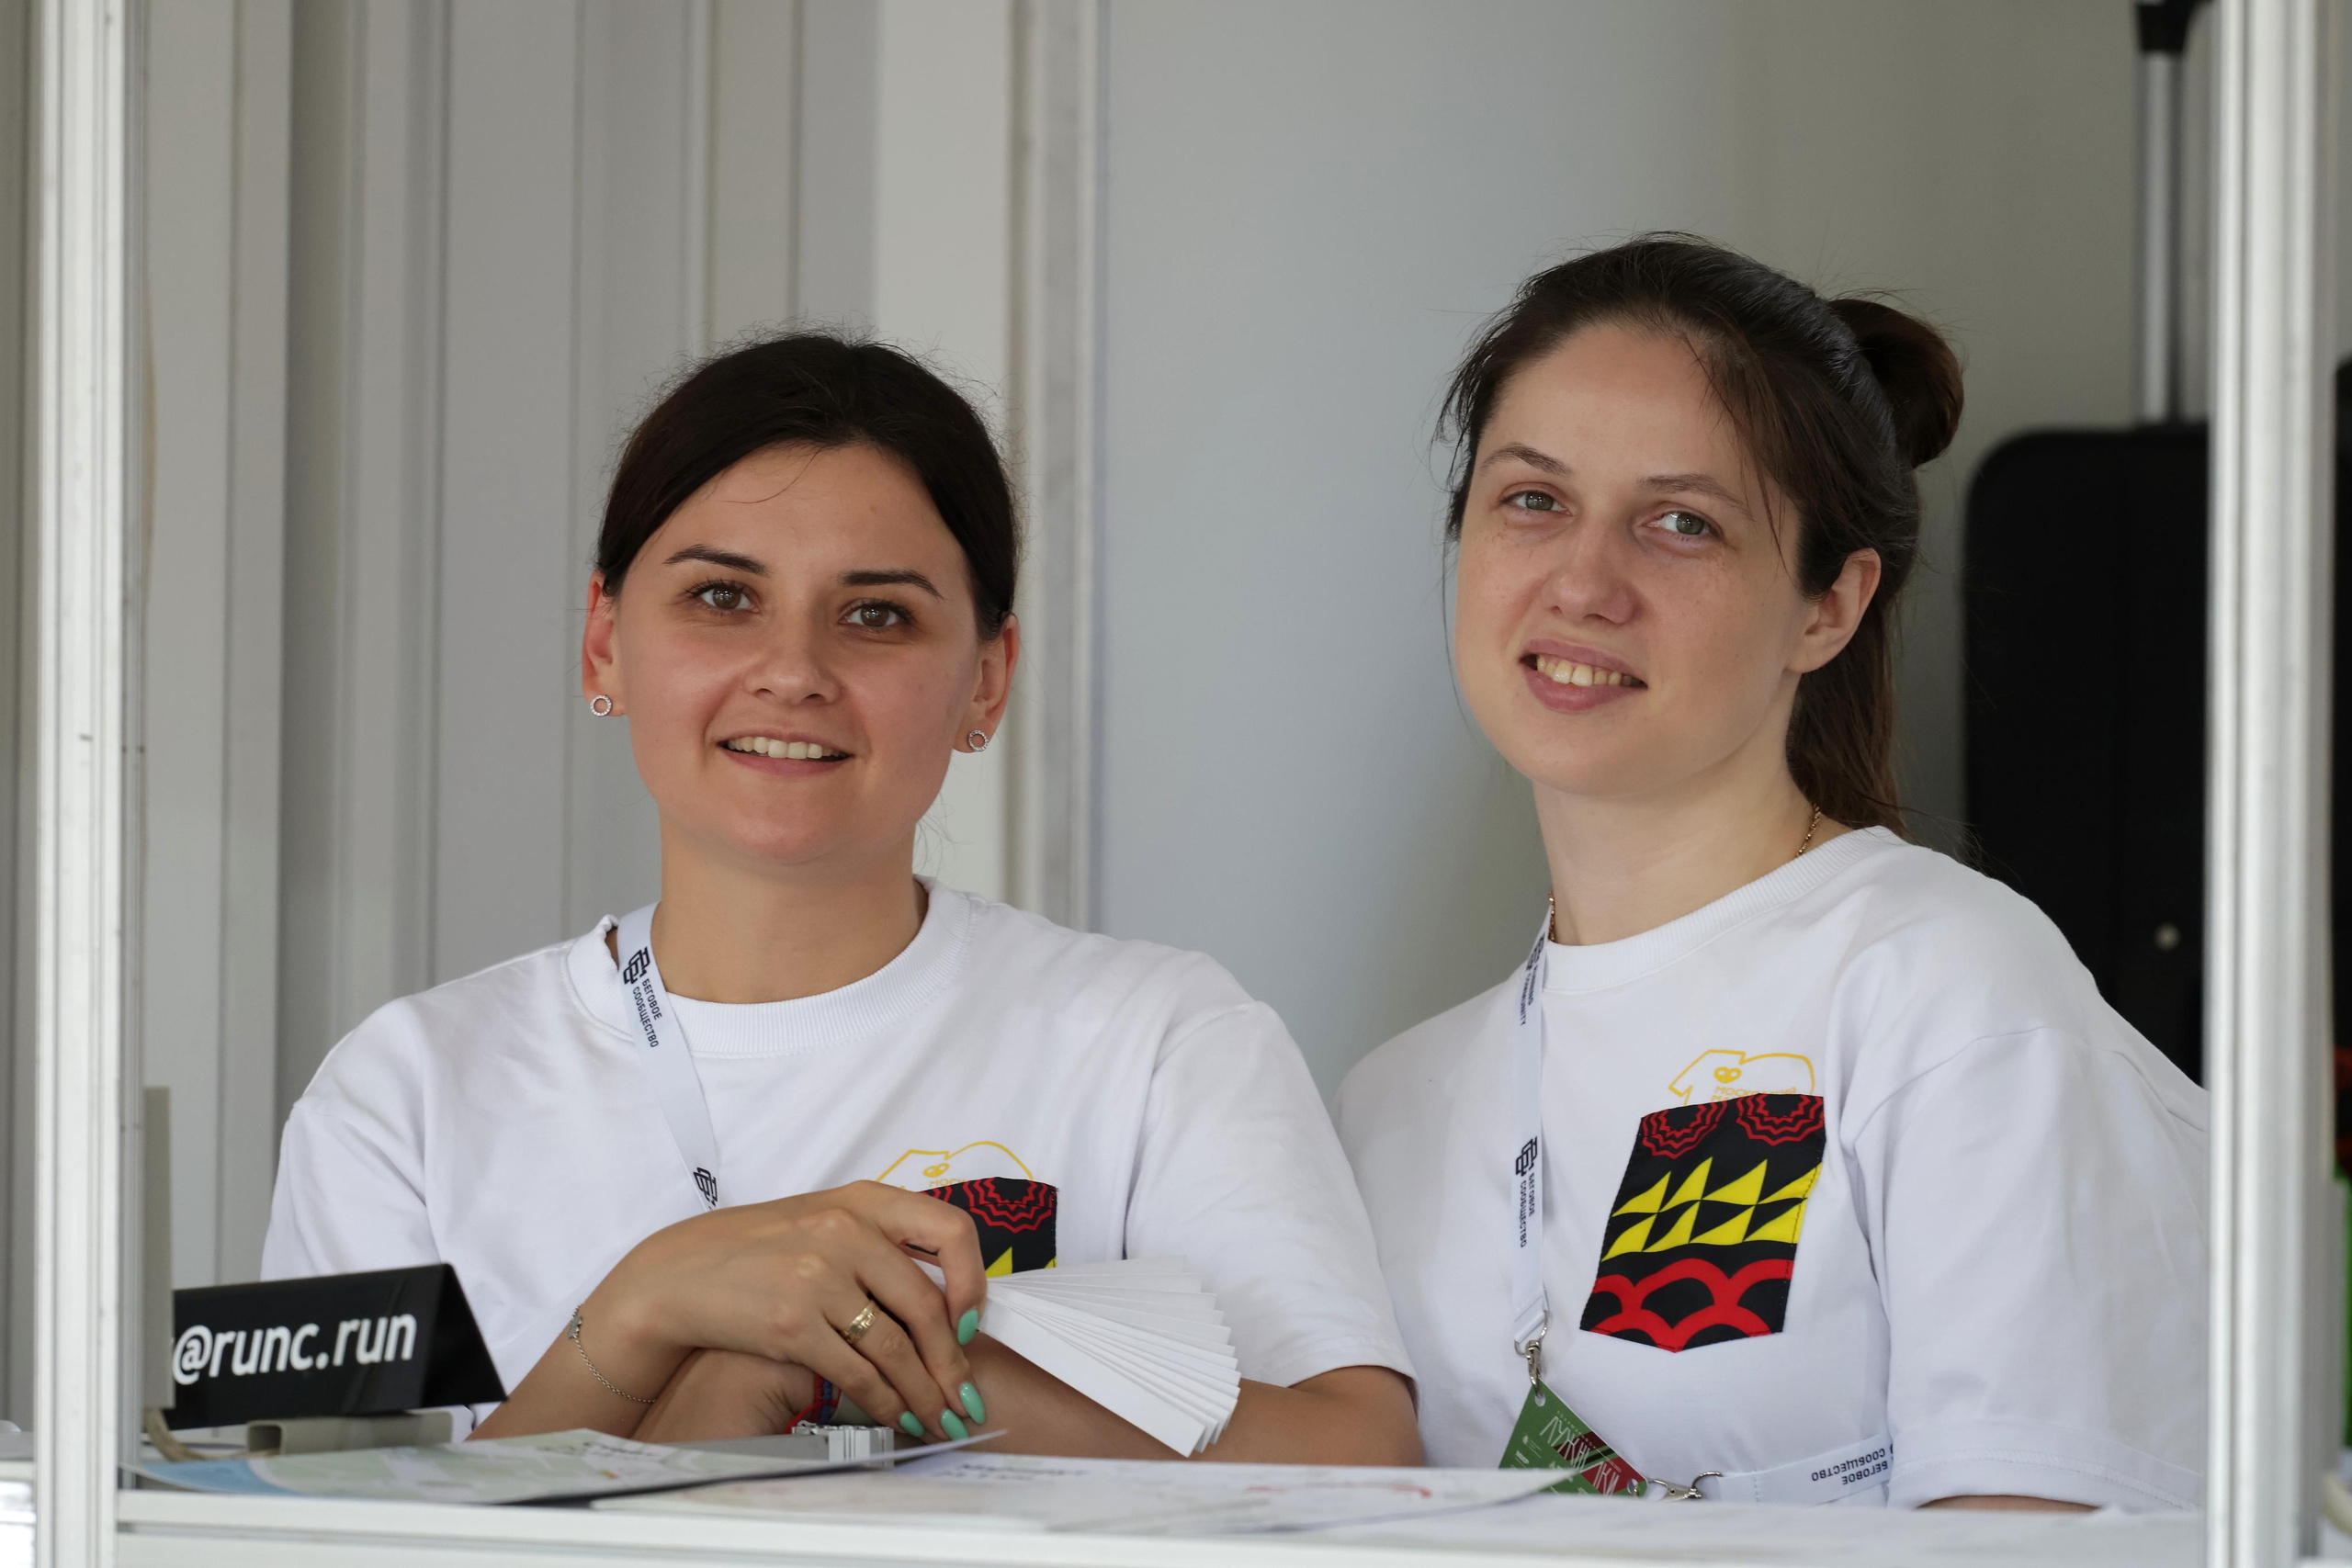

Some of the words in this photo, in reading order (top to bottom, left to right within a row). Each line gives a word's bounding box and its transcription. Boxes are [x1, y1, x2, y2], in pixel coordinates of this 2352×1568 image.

[632, 987, 659, 1048] СООБЩЕСТВО
[642, 978, 662, 1021] БЕГОВОЕ
[1520, 1179, 1528, 1248] СООБЩЕСТВО
[1811, 1448, 1886, 1482] СООБЩЕСТВО
[1841, 1460, 1889, 1485] БЕГОВОЕ
